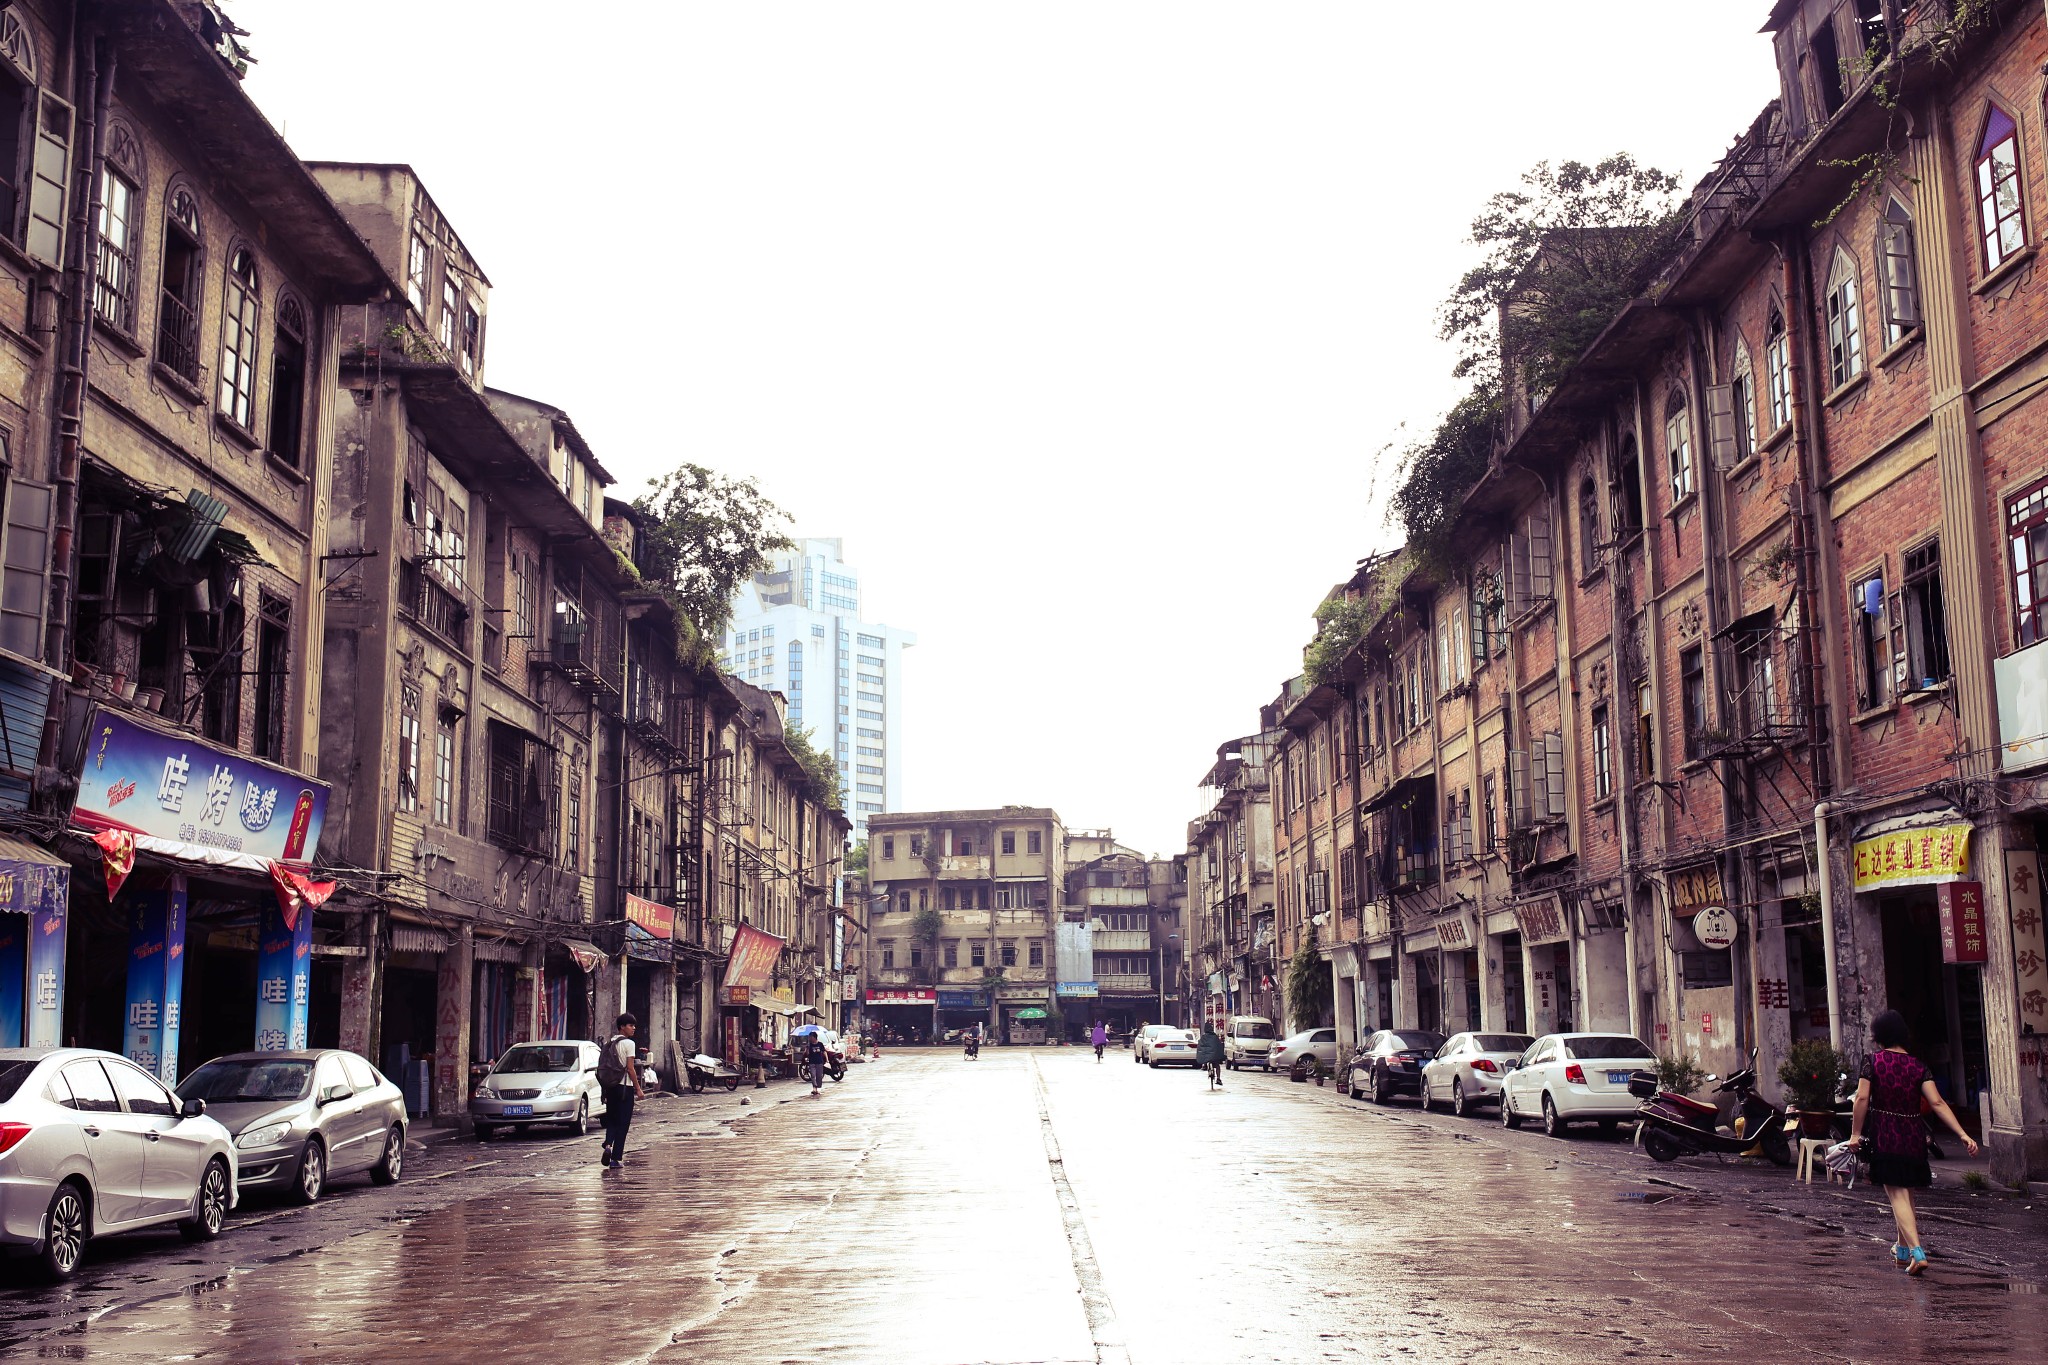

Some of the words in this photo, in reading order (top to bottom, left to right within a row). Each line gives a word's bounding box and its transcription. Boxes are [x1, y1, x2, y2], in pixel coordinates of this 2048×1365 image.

[157, 753, 234, 826] 哇烤
[1961, 890, 1981, 952] 水晶银饰
[1535, 971, 1554, 980] 批发
[1758, 979, 1789, 1009] 鞋
[162, 1000, 178, 1083] 哇烤
[292, 971, 307, 1050] 哇烤
